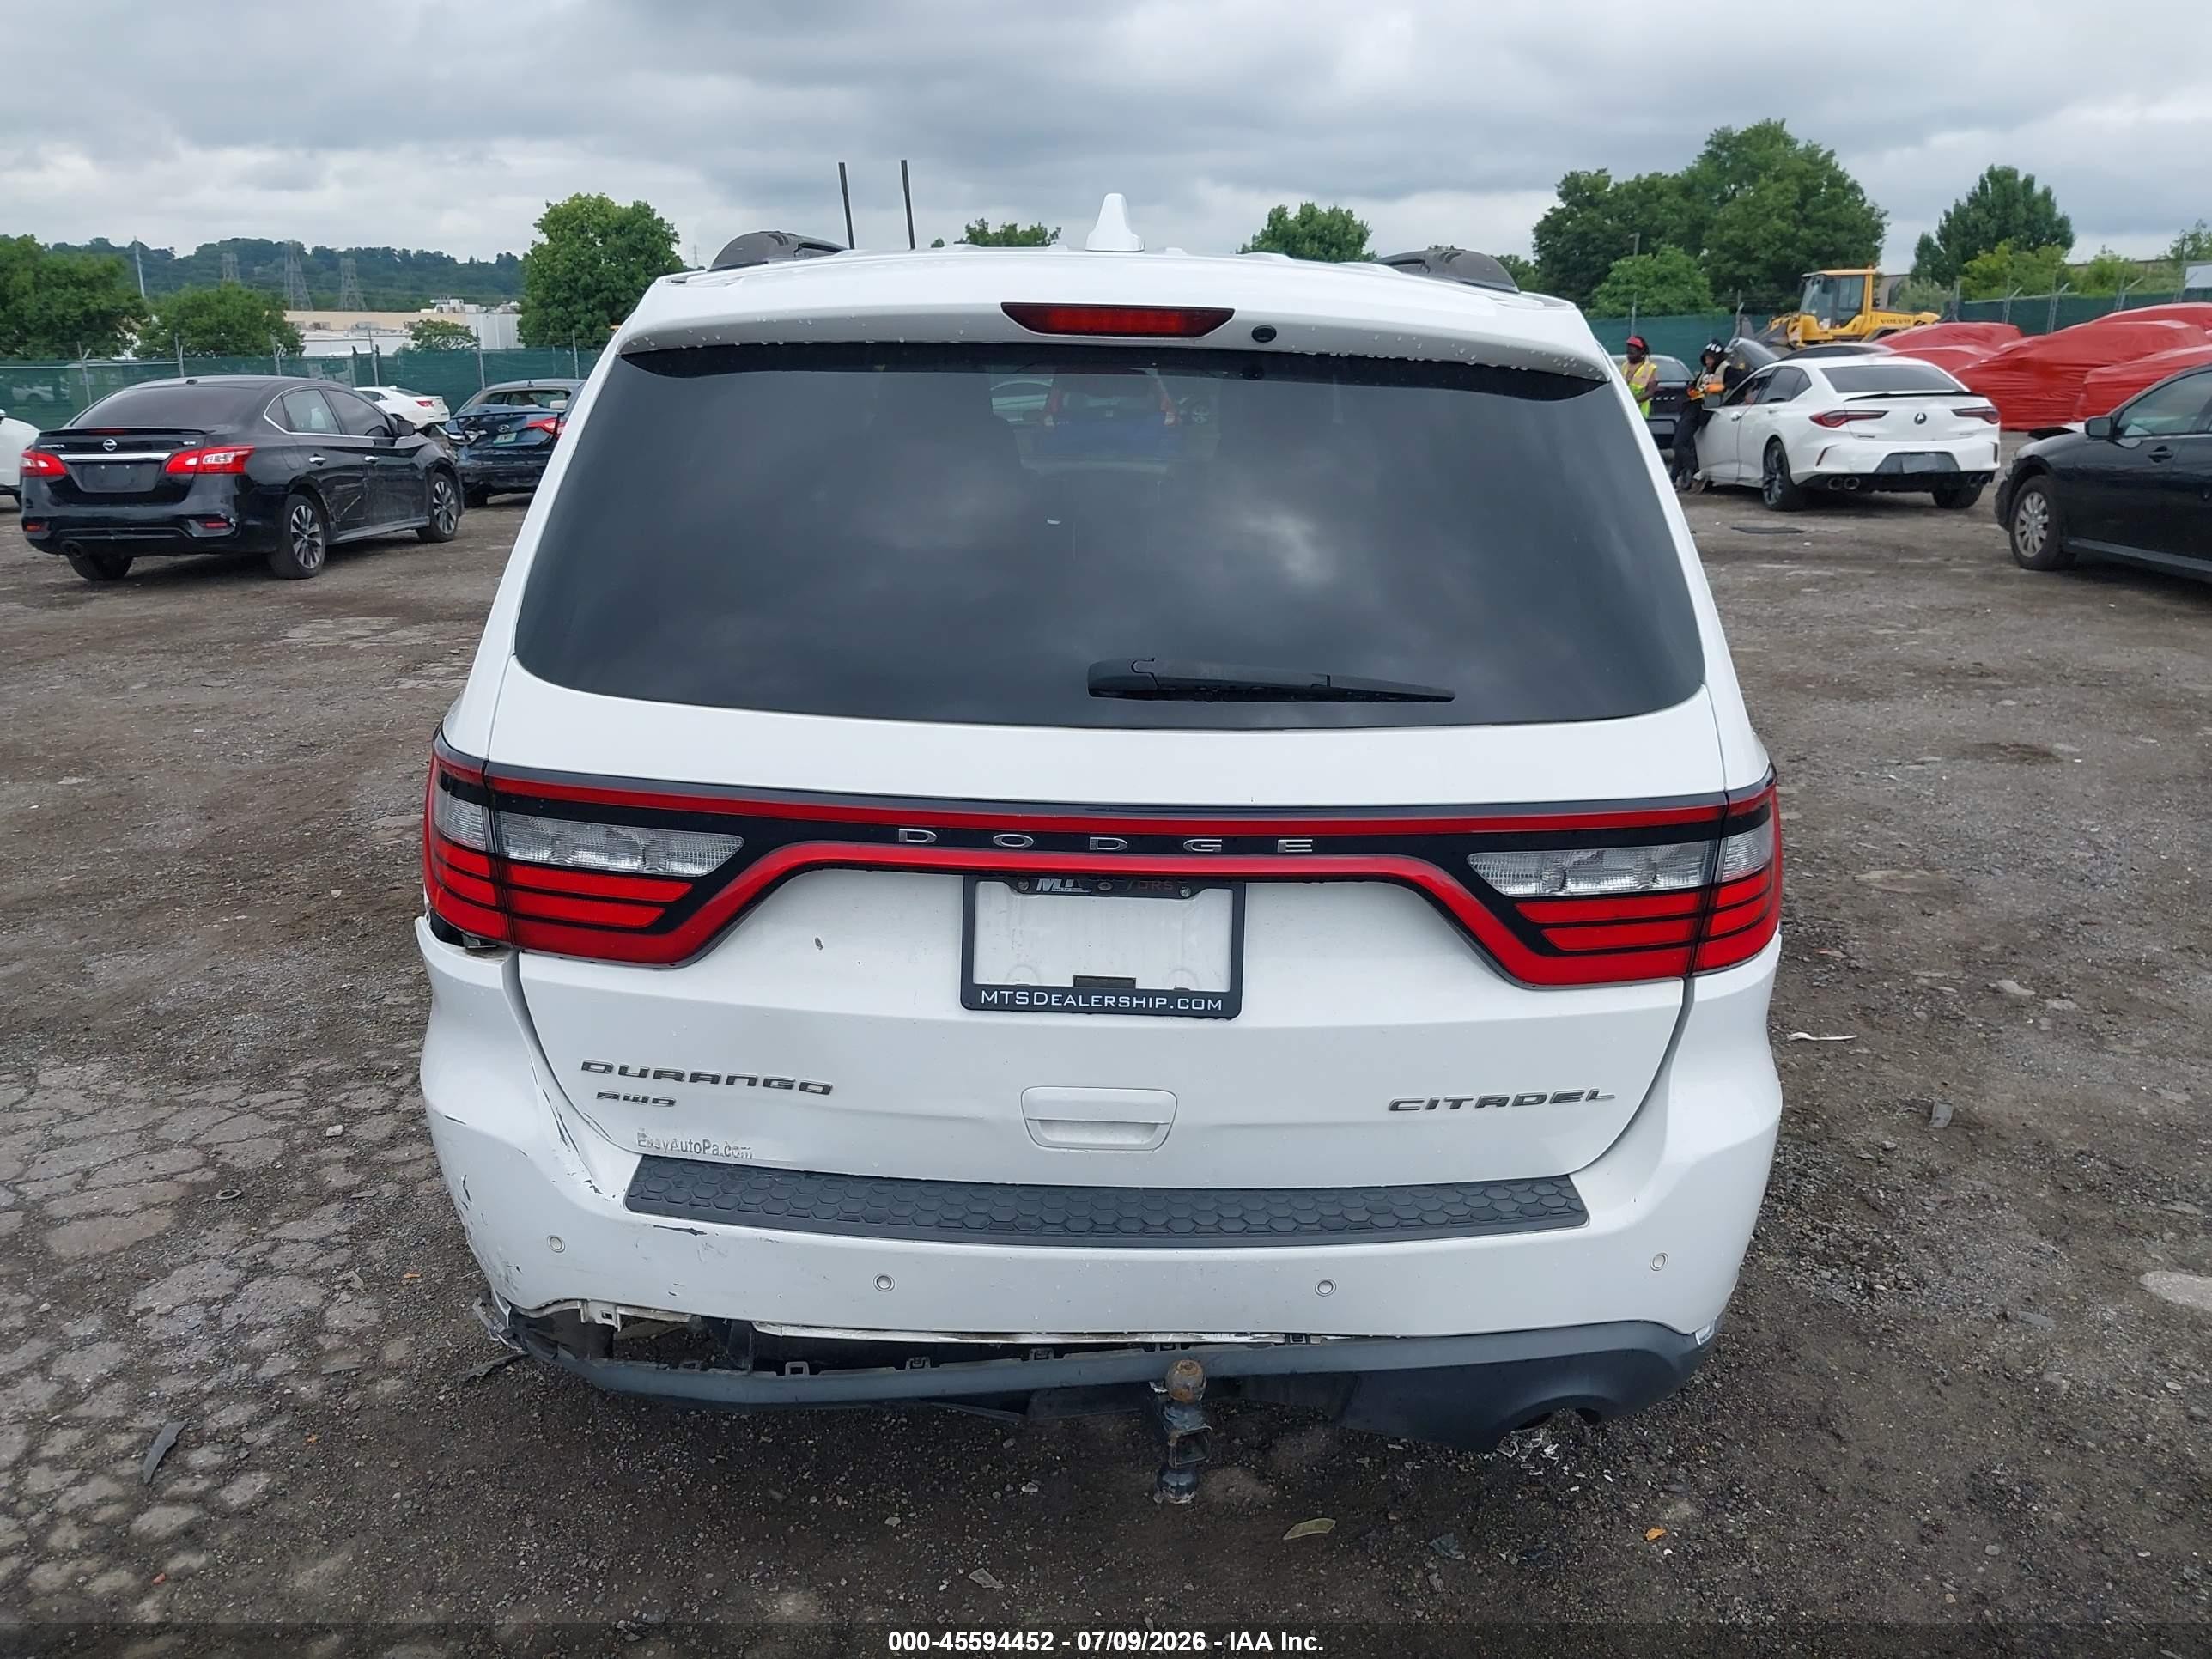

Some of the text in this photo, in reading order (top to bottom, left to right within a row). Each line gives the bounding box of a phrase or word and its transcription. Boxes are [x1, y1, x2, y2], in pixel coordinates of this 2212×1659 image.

[897, 828, 1314, 854] DODGE
[580, 1058, 834, 1096] DURANGO
[596, 1090, 678, 1108] AWD
[1388, 1087, 1616, 1112] CITADEL
[636, 1130, 753, 1160] EasyAutoPa.com
